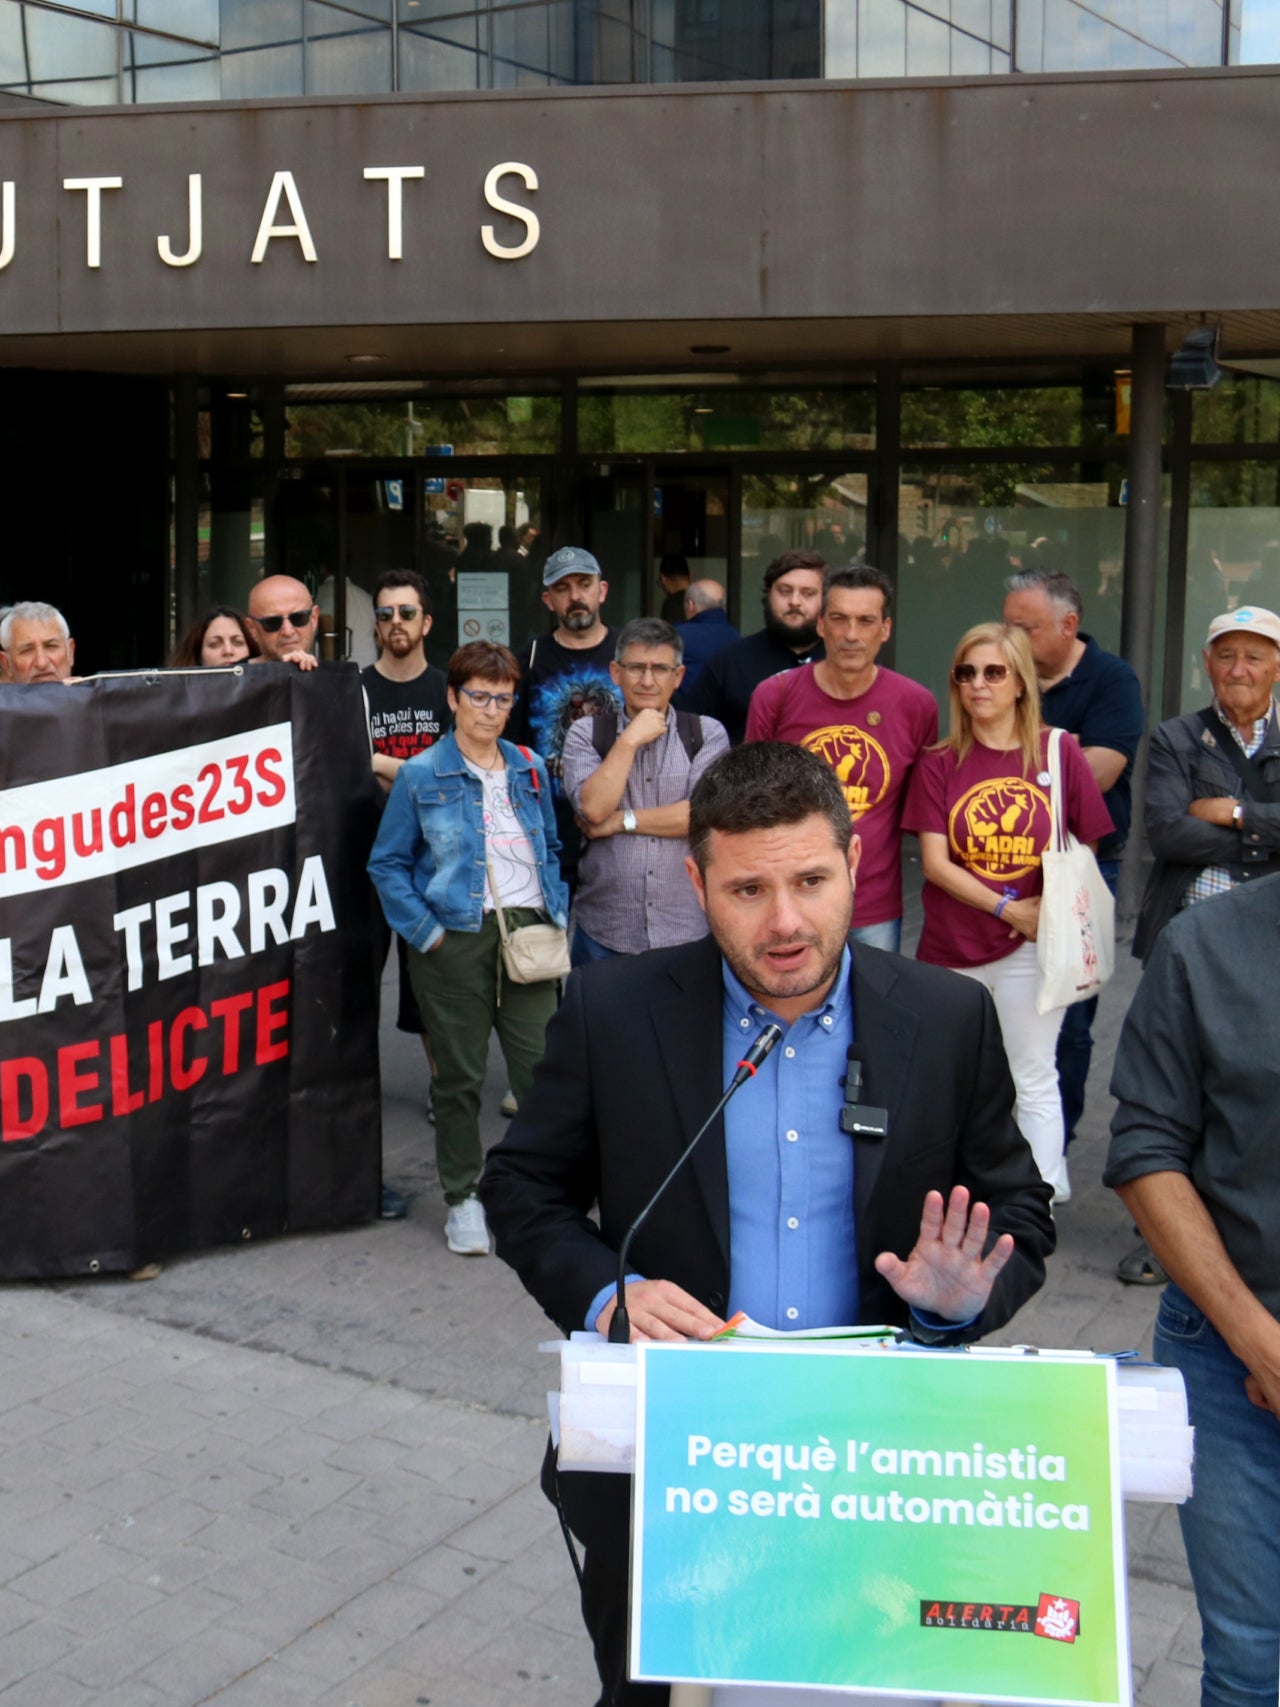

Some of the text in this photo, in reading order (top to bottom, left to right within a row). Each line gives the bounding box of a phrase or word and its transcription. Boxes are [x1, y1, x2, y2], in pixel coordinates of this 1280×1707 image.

[414, 710, 433, 721] veu
[113, 855, 336, 992] TERRA
[0, 979, 290, 1142] DELICTE
[687, 1435, 1067, 1482] Perquè l'amnistia
[665, 1482, 1090, 1531] no serà automàtica
[926, 1603, 1029, 1623] ALERTA
